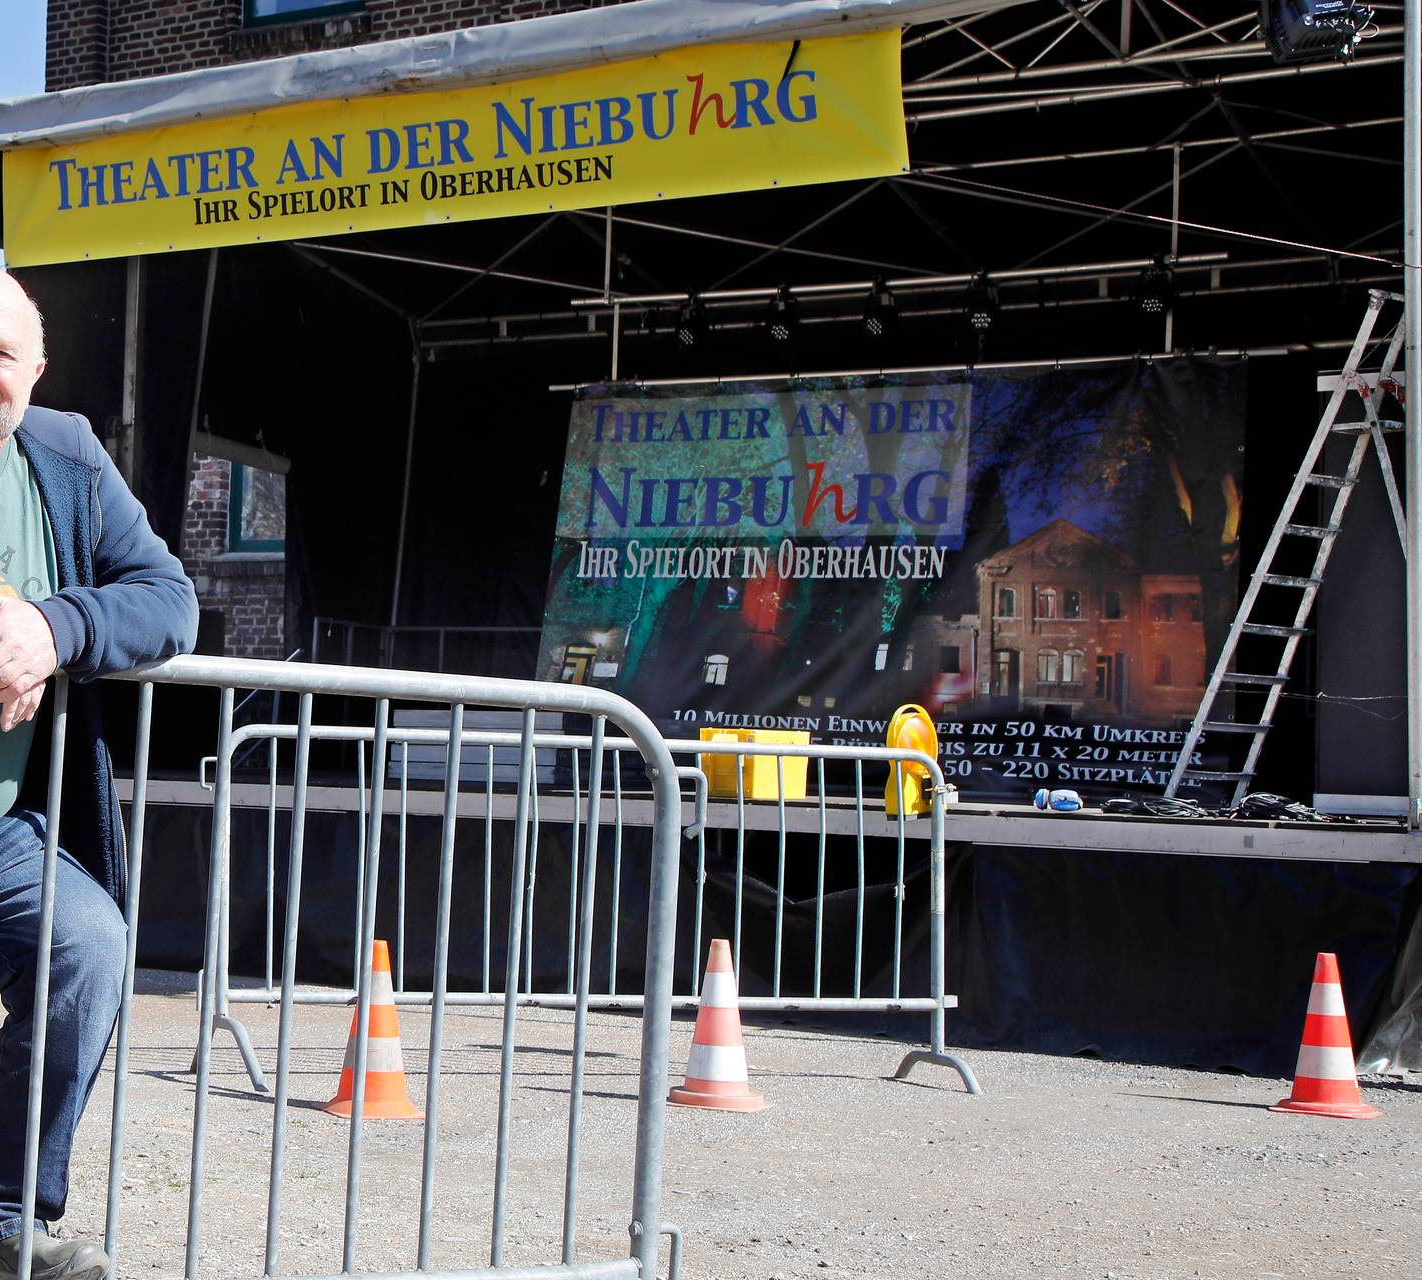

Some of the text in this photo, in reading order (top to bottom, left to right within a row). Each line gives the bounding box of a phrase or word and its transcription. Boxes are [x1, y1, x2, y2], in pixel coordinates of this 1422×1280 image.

[49, 146, 258, 211] THEATER
[276, 134, 346, 185] AN
[366, 119, 474, 175] DER
[194, 155, 614, 225] IHR SPIELORT IN OBERHAUSEN
[591, 400, 956, 443] THEATER AN DER
[577, 539, 947, 579] IHR SPIELORT IN OBERHAUSEN
[705, 710, 821, 731] MILLIONEN
[971, 723, 996, 736] IN
[1005, 720, 1035, 737] 50
[1043, 724, 1083, 740] KM
[973, 742, 1002, 757] ZU
[1013, 742, 1042, 758] 11
[1078, 746, 1108, 761] 20
[1002, 760, 1049, 779] 220
[1058, 764, 1202, 787] SITZPLÄTE
